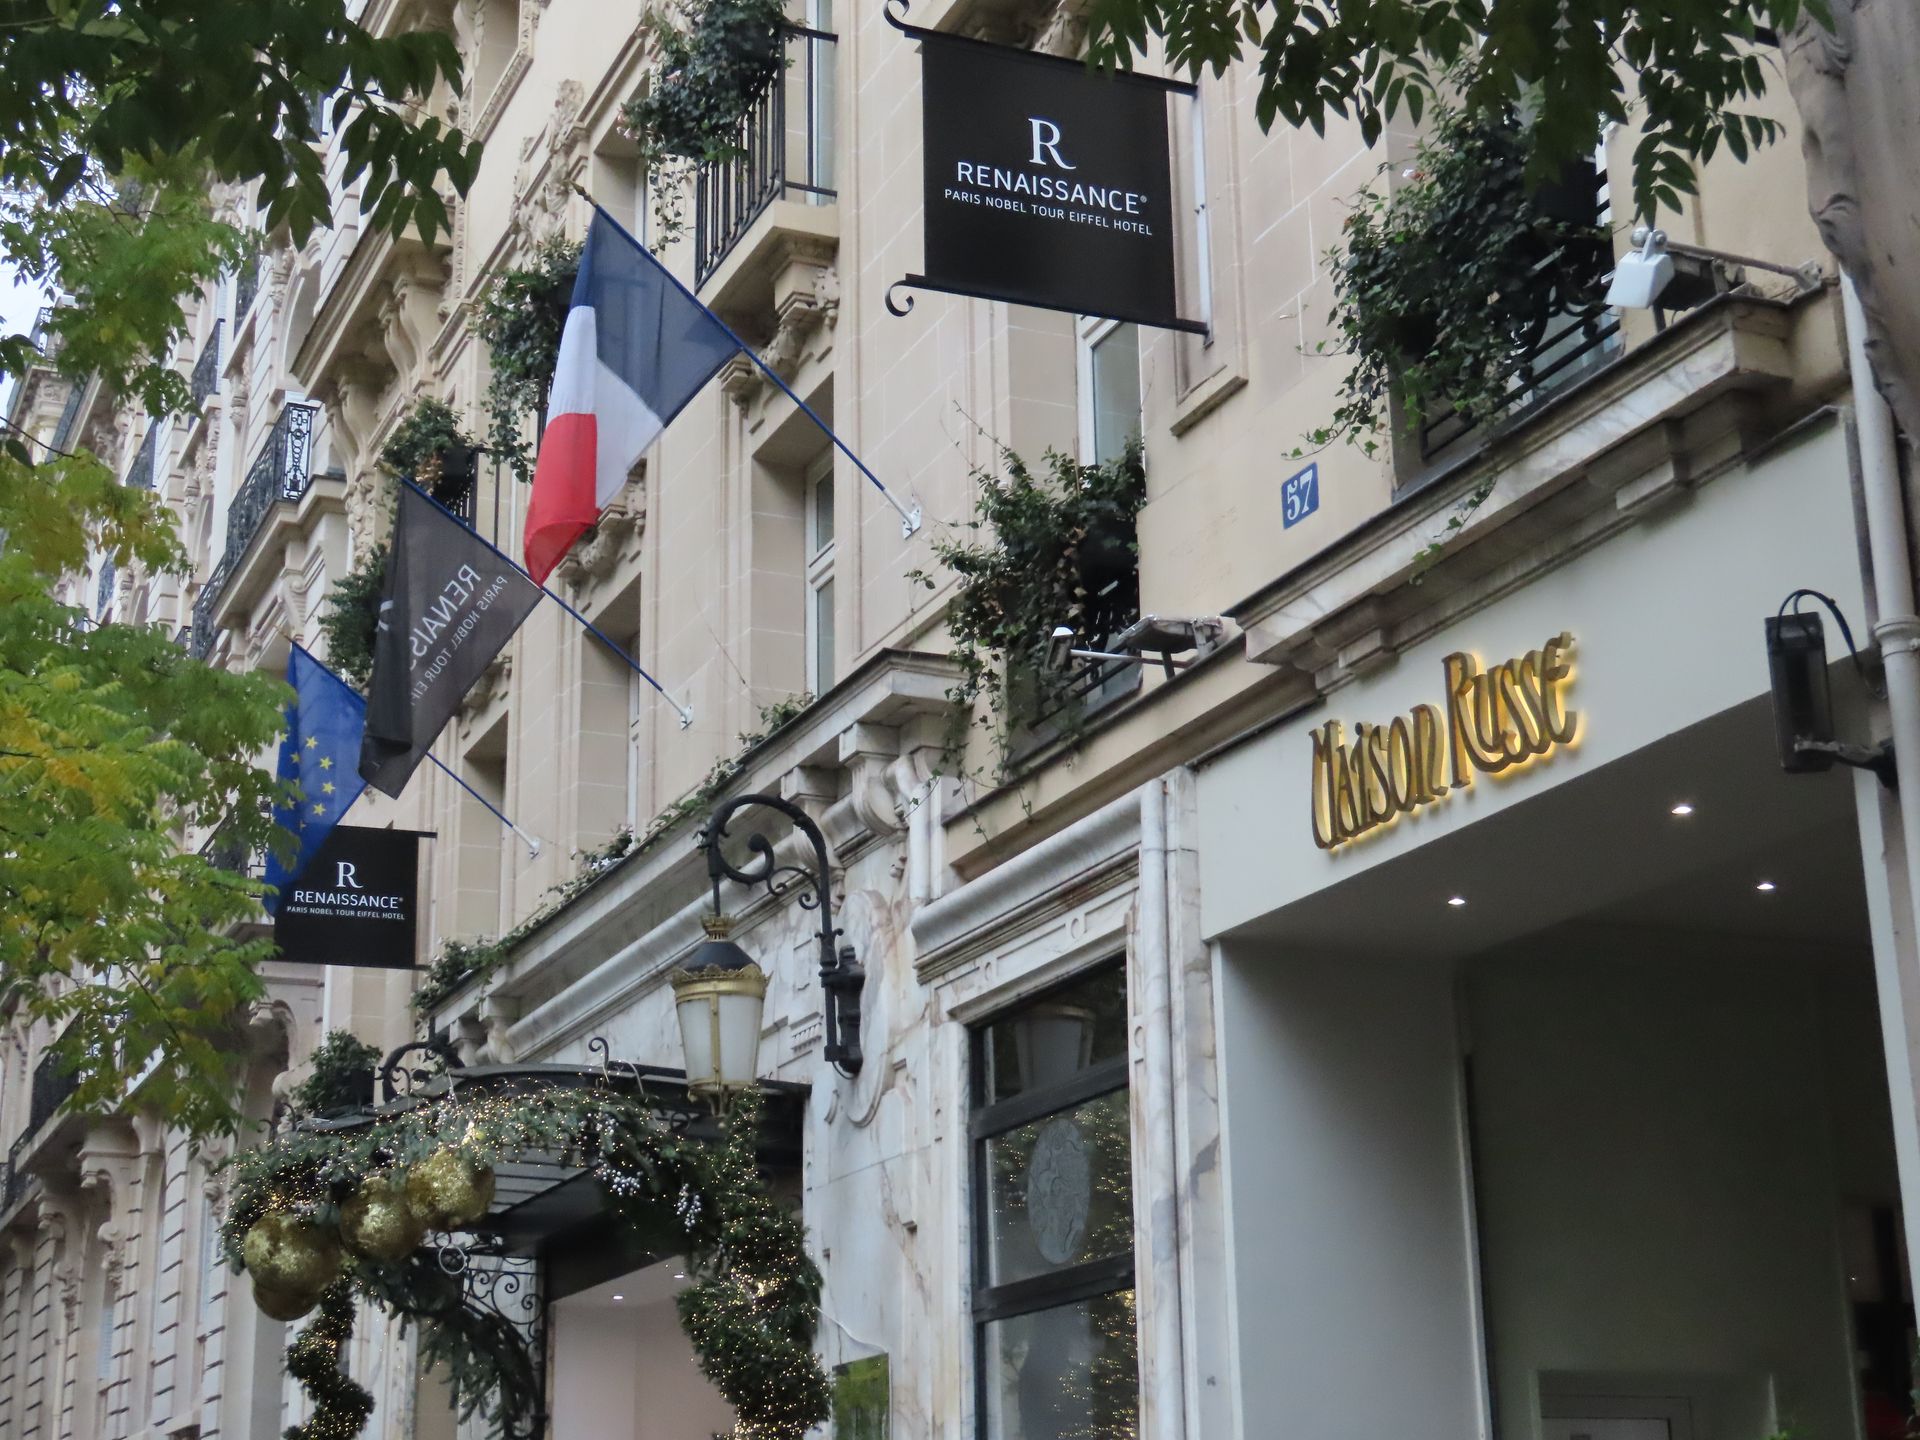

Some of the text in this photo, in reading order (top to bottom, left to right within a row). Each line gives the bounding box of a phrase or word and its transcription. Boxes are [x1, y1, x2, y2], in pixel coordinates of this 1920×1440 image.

[1028, 117, 1077, 170] R
[945, 188, 1153, 236] PARIS NOBEL TOUR EIFFEL HOTEL
[1287, 469, 1313, 521] 57
[336, 861, 364, 889] R
[286, 906, 308, 914] PARIS
[335, 909, 355, 917] TOUR
[382, 912, 405, 920] HOTEL
